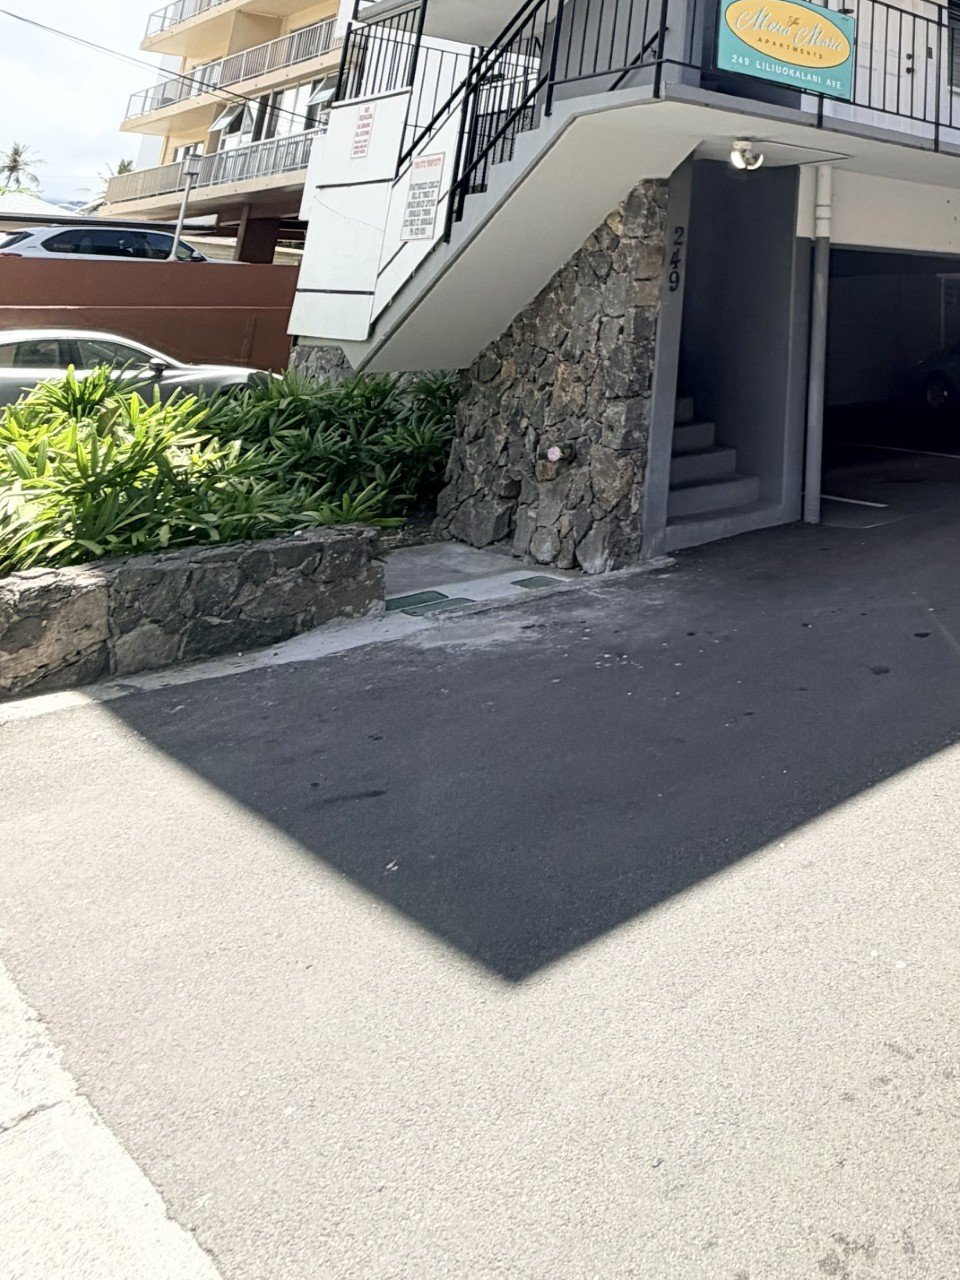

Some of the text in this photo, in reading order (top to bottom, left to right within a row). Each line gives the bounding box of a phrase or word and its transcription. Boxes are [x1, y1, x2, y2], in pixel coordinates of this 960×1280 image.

[758, 37, 823, 59] APARTMENTS
[731, 54, 749, 66] 249
[755, 61, 821, 84] LILIUOKALANI
[668, 226, 685, 292] 249
